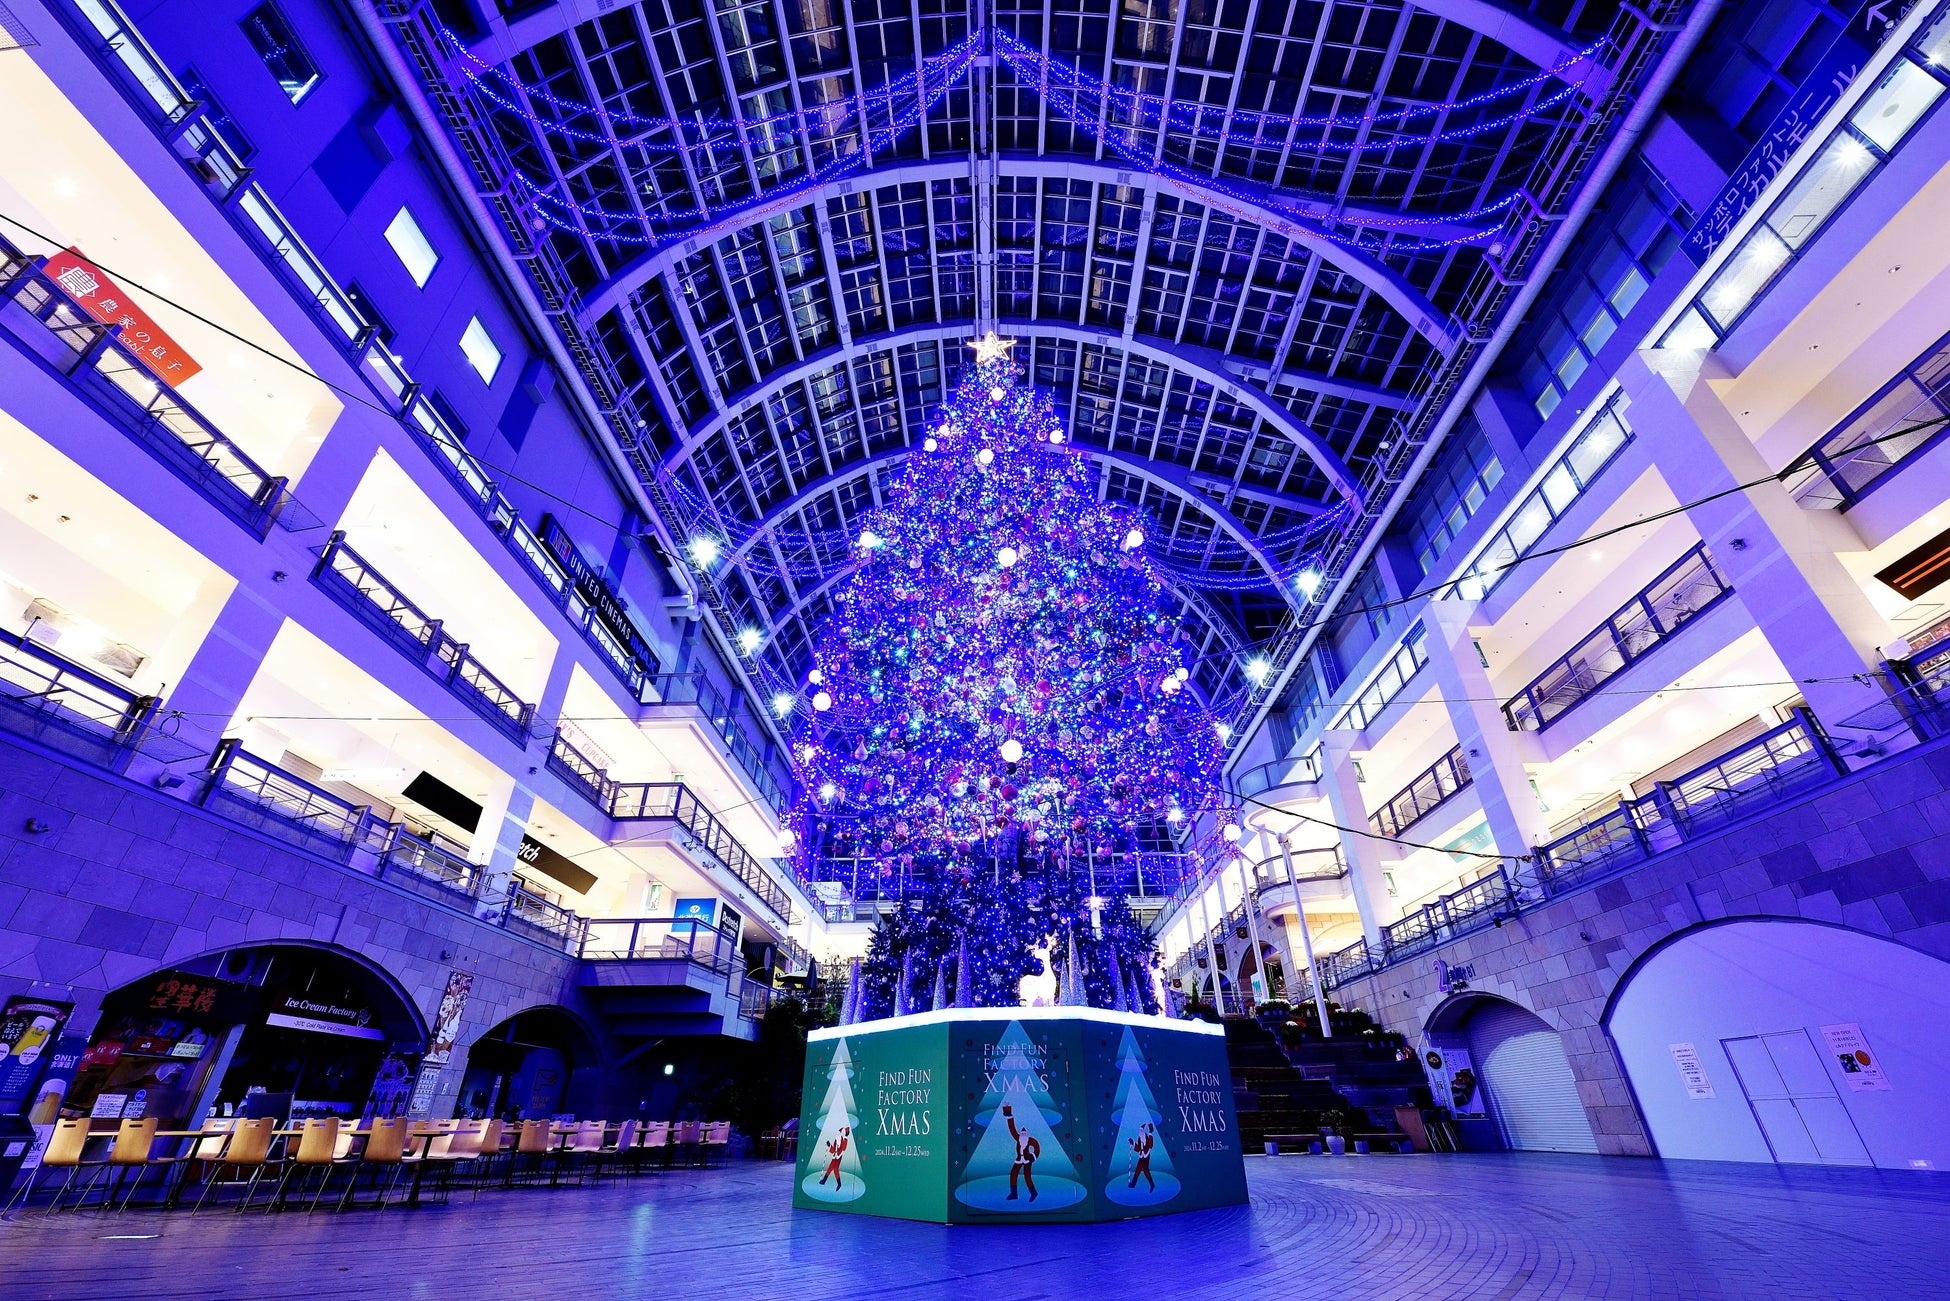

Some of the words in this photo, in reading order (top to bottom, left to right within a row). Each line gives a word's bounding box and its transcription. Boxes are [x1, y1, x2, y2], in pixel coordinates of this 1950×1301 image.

[1692, 92, 1814, 246] サッポロファクトリー
[1702, 64, 1858, 260] メディカルモール
[98, 298, 183, 372] 農家の息子
[570, 554, 600, 598] UNITED
[600, 594, 632, 641] CINEMAS
[285, 997, 300, 1008] Ice
[300, 1000, 328, 1013] Cream
[328, 1005, 357, 1019] Factory
[54, 1054, 78, 1062] ONLY
